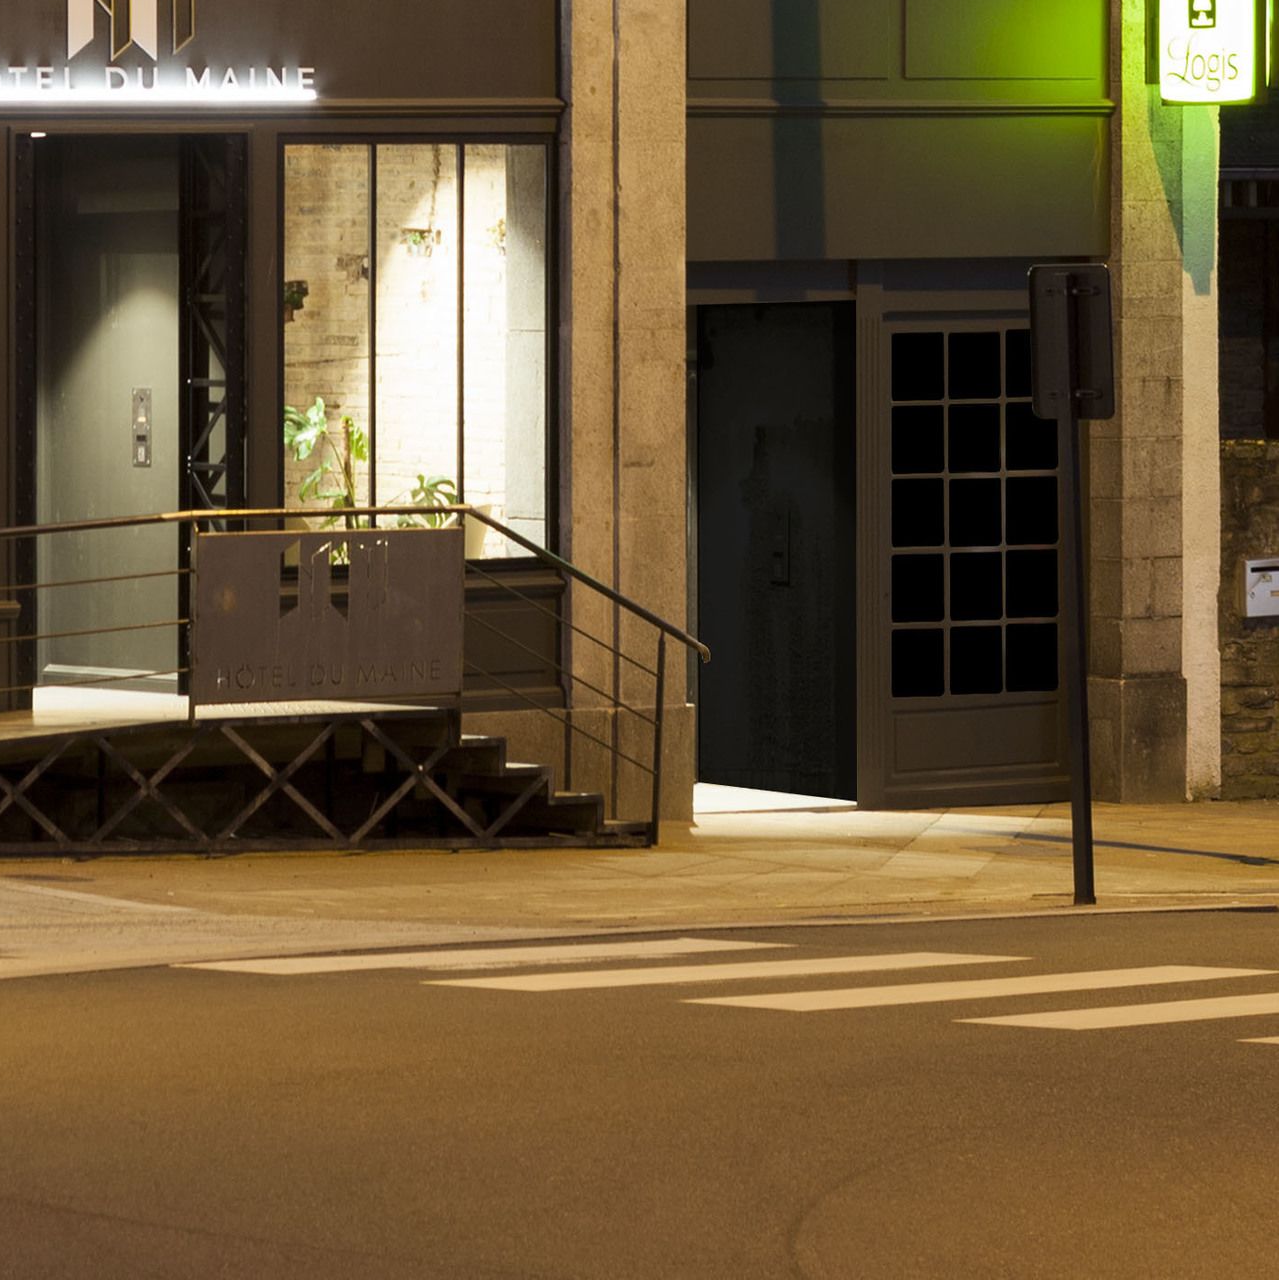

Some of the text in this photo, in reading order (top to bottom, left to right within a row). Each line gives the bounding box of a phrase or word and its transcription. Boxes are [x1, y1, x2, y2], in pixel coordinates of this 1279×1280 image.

[1167, 32, 1239, 92] Logis
[105, 66, 159, 92] DU
[185, 66, 316, 92] MAINE
[310, 663, 346, 687] DU
[356, 658, 442, 686] MAINE
